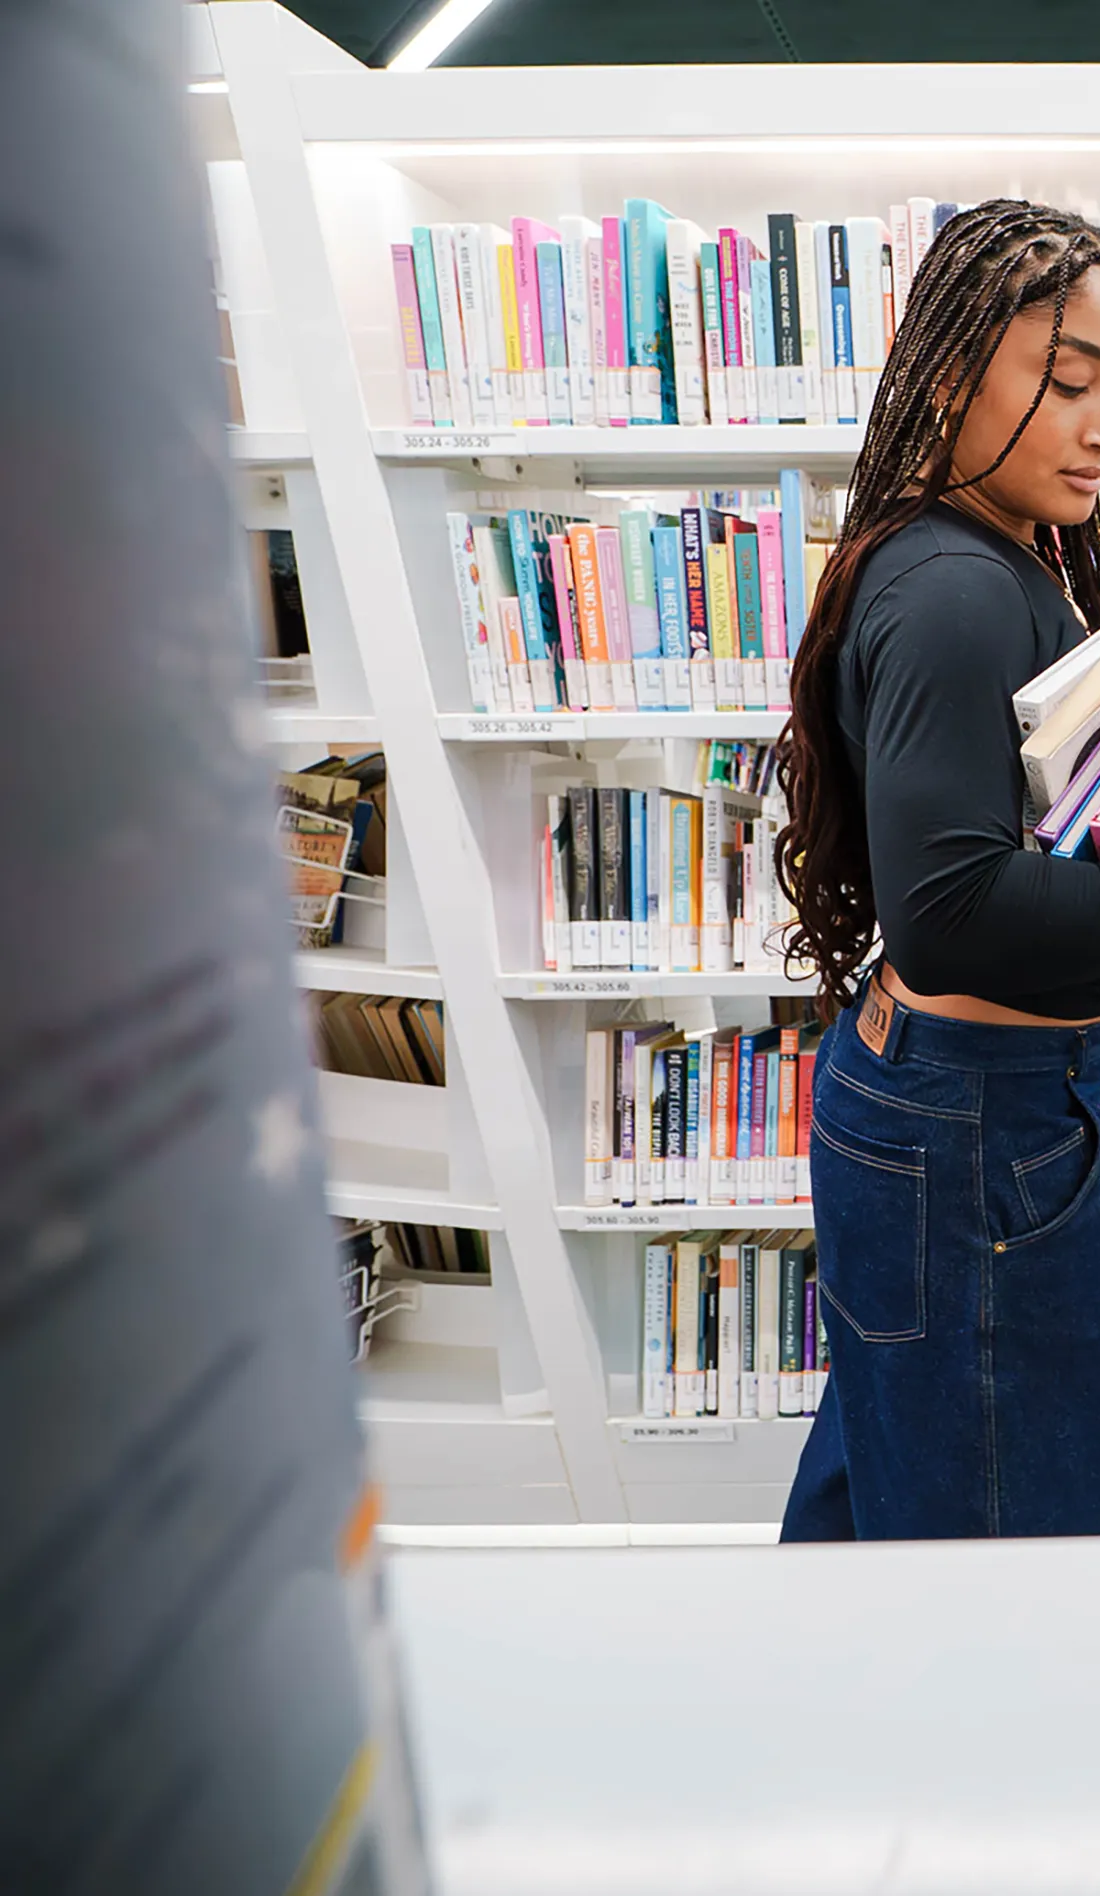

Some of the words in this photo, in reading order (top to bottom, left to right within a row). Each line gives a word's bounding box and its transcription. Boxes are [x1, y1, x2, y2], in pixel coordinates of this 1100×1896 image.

[896, 222, 907, 245] THE
[916, 214, 927, 236] THE
[897, 248, 908, 277] NEW
[461, 265, 473, 290] THESE
[779, 266, 790, 295] COME
[837, 304, 847, 355] Overcoming
[404, 435, 442, 448] 305.24
[452, 435, 491, 448] 305.26
[577, 533, 592, 557] the
[684, 513, 699, 560] WHAT'S
[580, 559, 597, 607] PANIC
[661, 576, 677, 590] IN
[688, 561, 701, 588] HER
[661, 592, 677, 619] HER
[690, 589, 704, 628] NAME
[712, 571, 727, 642] AMAZONS
[584, 608, 600, 648] years
[471, 721, 507, 733] 305.26
[517, 721, 552, 733] 305.42
[552, 981, 586, 992] 305.42
[669, 1068, 681, 1099] DON'T
[668, 1101, 681, 1131] LOOK
